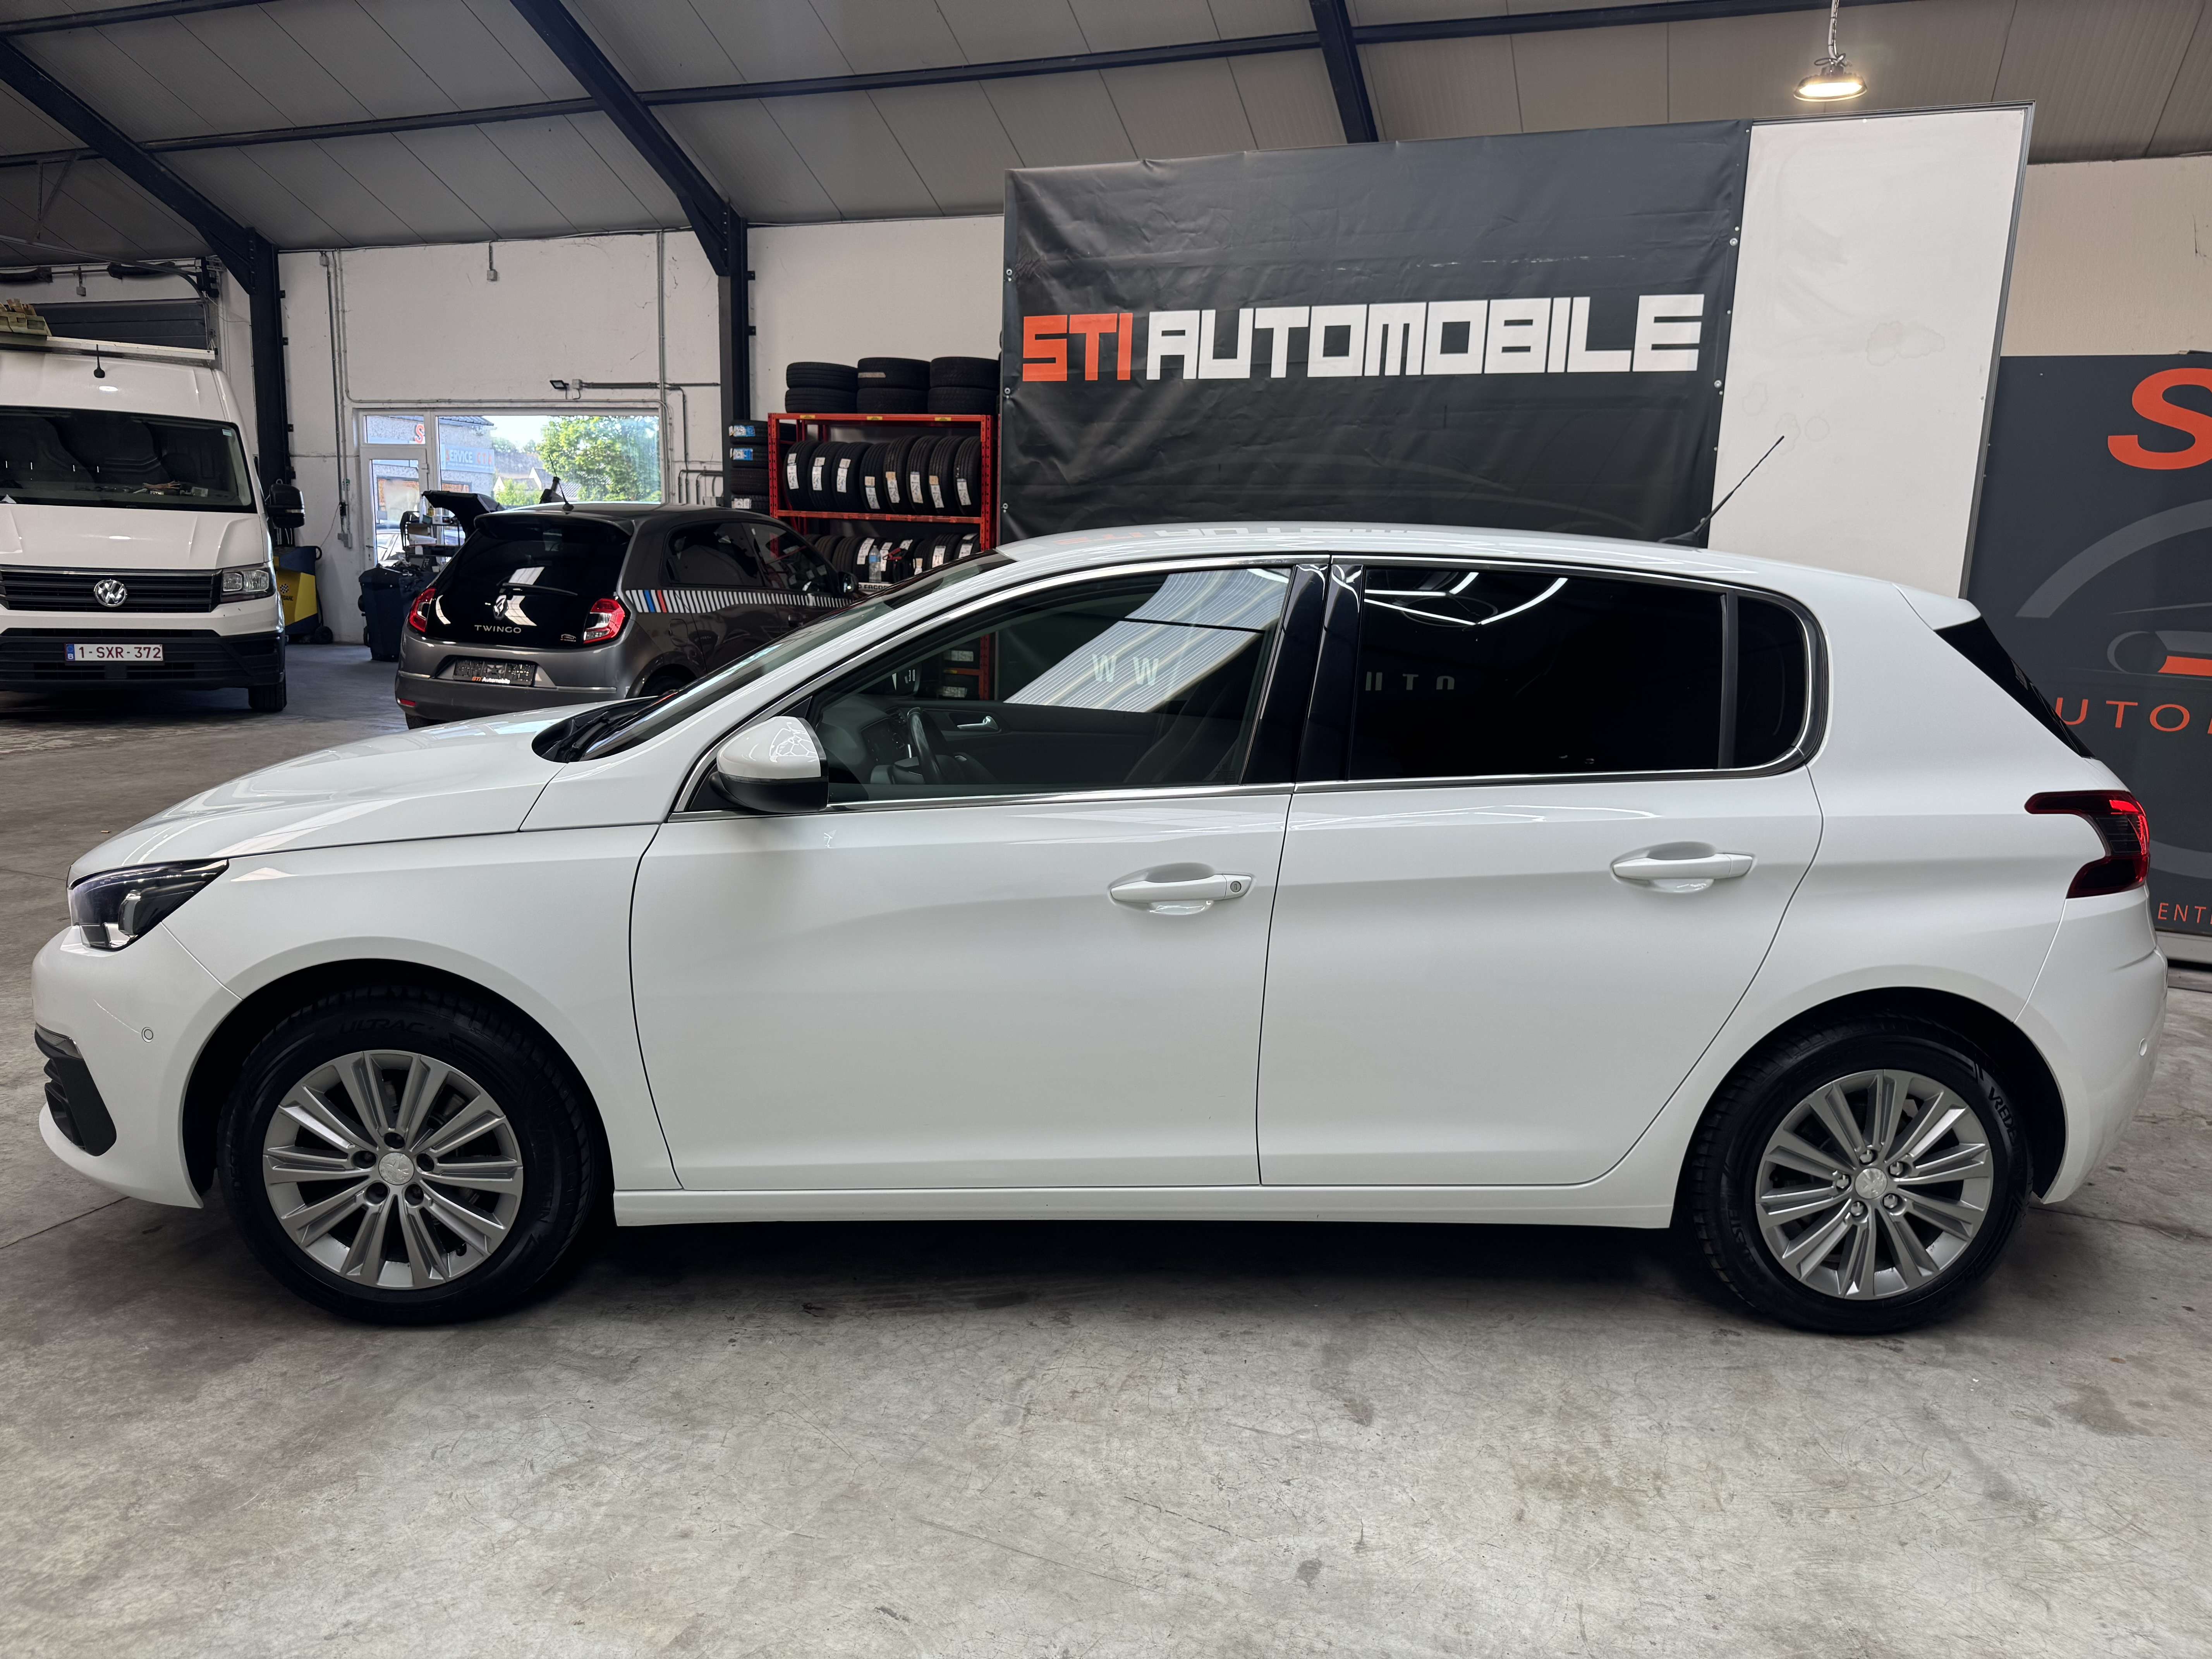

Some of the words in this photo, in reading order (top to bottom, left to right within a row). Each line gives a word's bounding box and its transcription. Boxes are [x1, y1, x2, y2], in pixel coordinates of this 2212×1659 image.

[1022, 312, 1133, 381] STI
[1146, 294, 1705, 380] AUTOMOBILE
[446, 449, 473, 464] SERVICE
[474, 625, 522, 634] TWINGO
[2055, 697, 2212, 734] UTO
[2158, 902, 2212, 925] ENT
